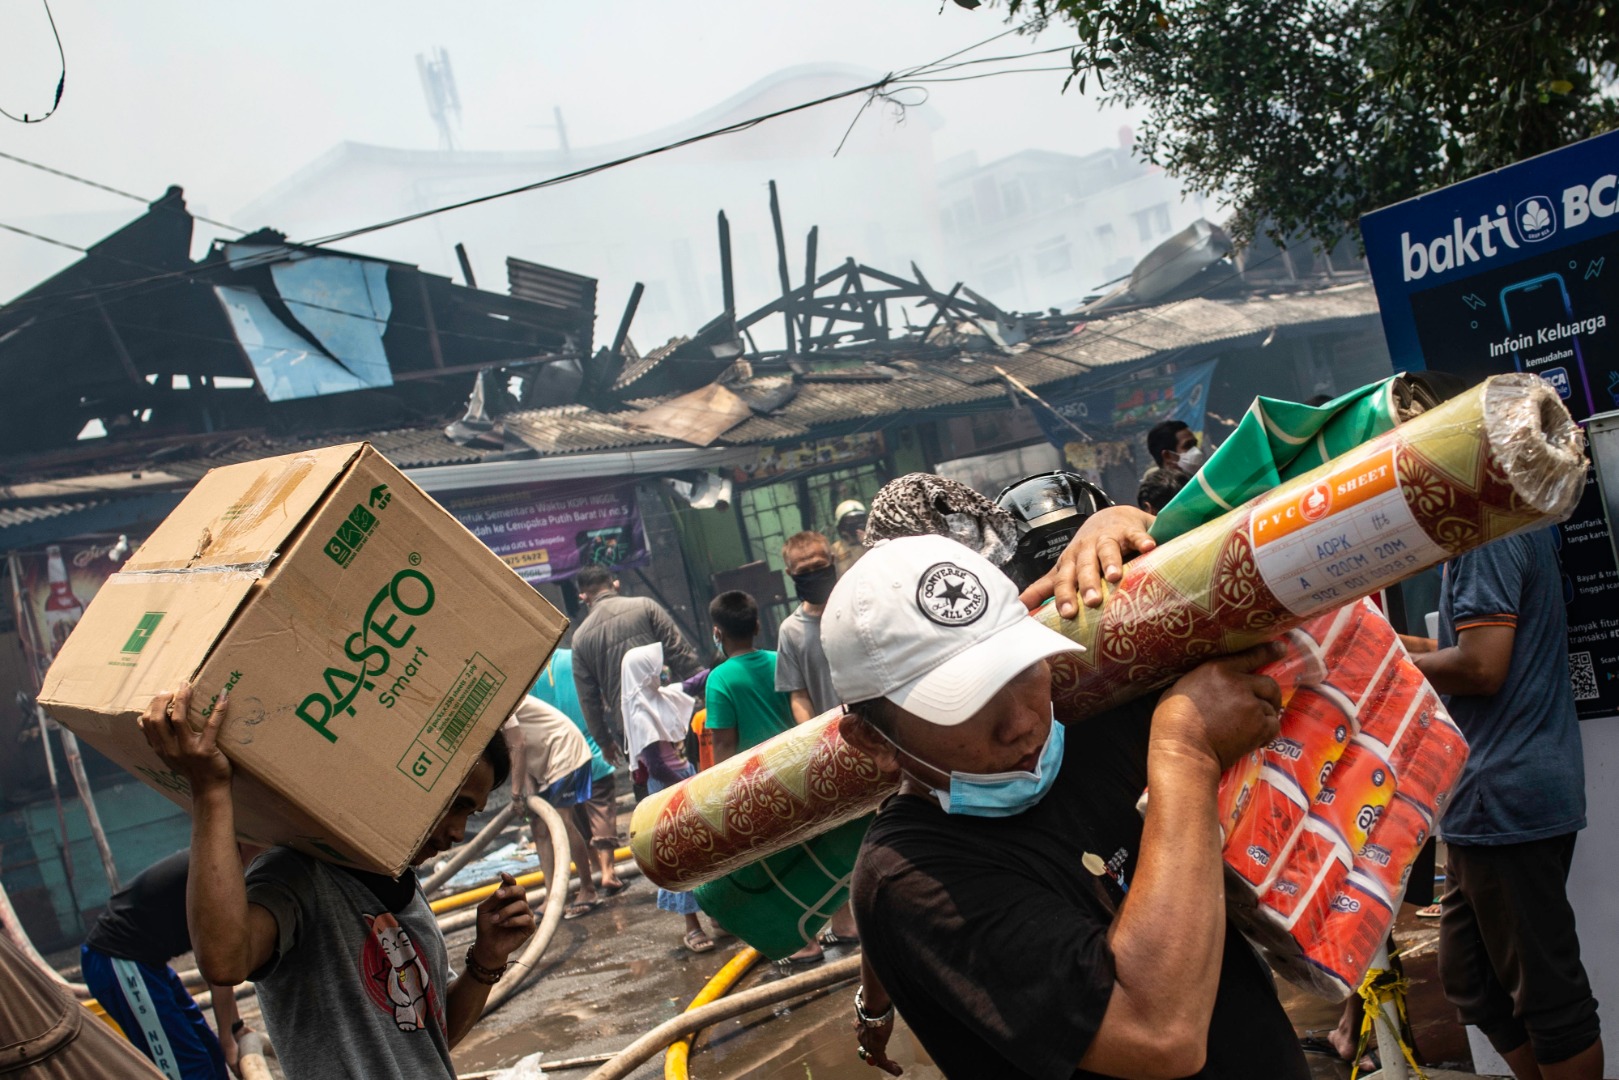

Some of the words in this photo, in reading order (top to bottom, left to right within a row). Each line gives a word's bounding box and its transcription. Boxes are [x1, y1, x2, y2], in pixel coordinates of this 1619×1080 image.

[1401, 204, 1520, 282] bakti
[1562, 174, 1619, 229] BC
[1490, 333, 1533, 357] Infoin
[1537, 315, 1606, 344] Keluarga
[1525, 349, 1574, 368] kemudahan
[1337, 464, 1388, 496] SHEET
[378, 492, 392, 510] UP
[493, 523, 505, 533] ke
[505, 517, 547, 531] Cempaka
[548, 513, 573, 524] Putih
[573, 510, 597, 521] Barat
[330, 542, 341, 554] 6
[1567, 533, 1589, 544] tanpa
[1300, 576, 1311, 590] A
[1326, 554, 1369, 578] 120CM
[1374, 539, 1407, 560] 20M
[925, 568, 967, 598] CONVERSE
[1577, 573, 1596, 583] Bayar
[1579, 583, 1605, 594] tinggal
[941, 609, 962, 619] ALL
[963, 594, 981, 615] STAR
[1569, 631, 1607, 644] transaksi
[295, 568, 436, 744] PASEO
[378, 645, 429, 709] Smart
[1265, 738, 1304, 762] nice
[412, 751, 434, 778] GT
[1247, 845, 1270, 867] nice
[1331, 891, 1361, 913] ice
